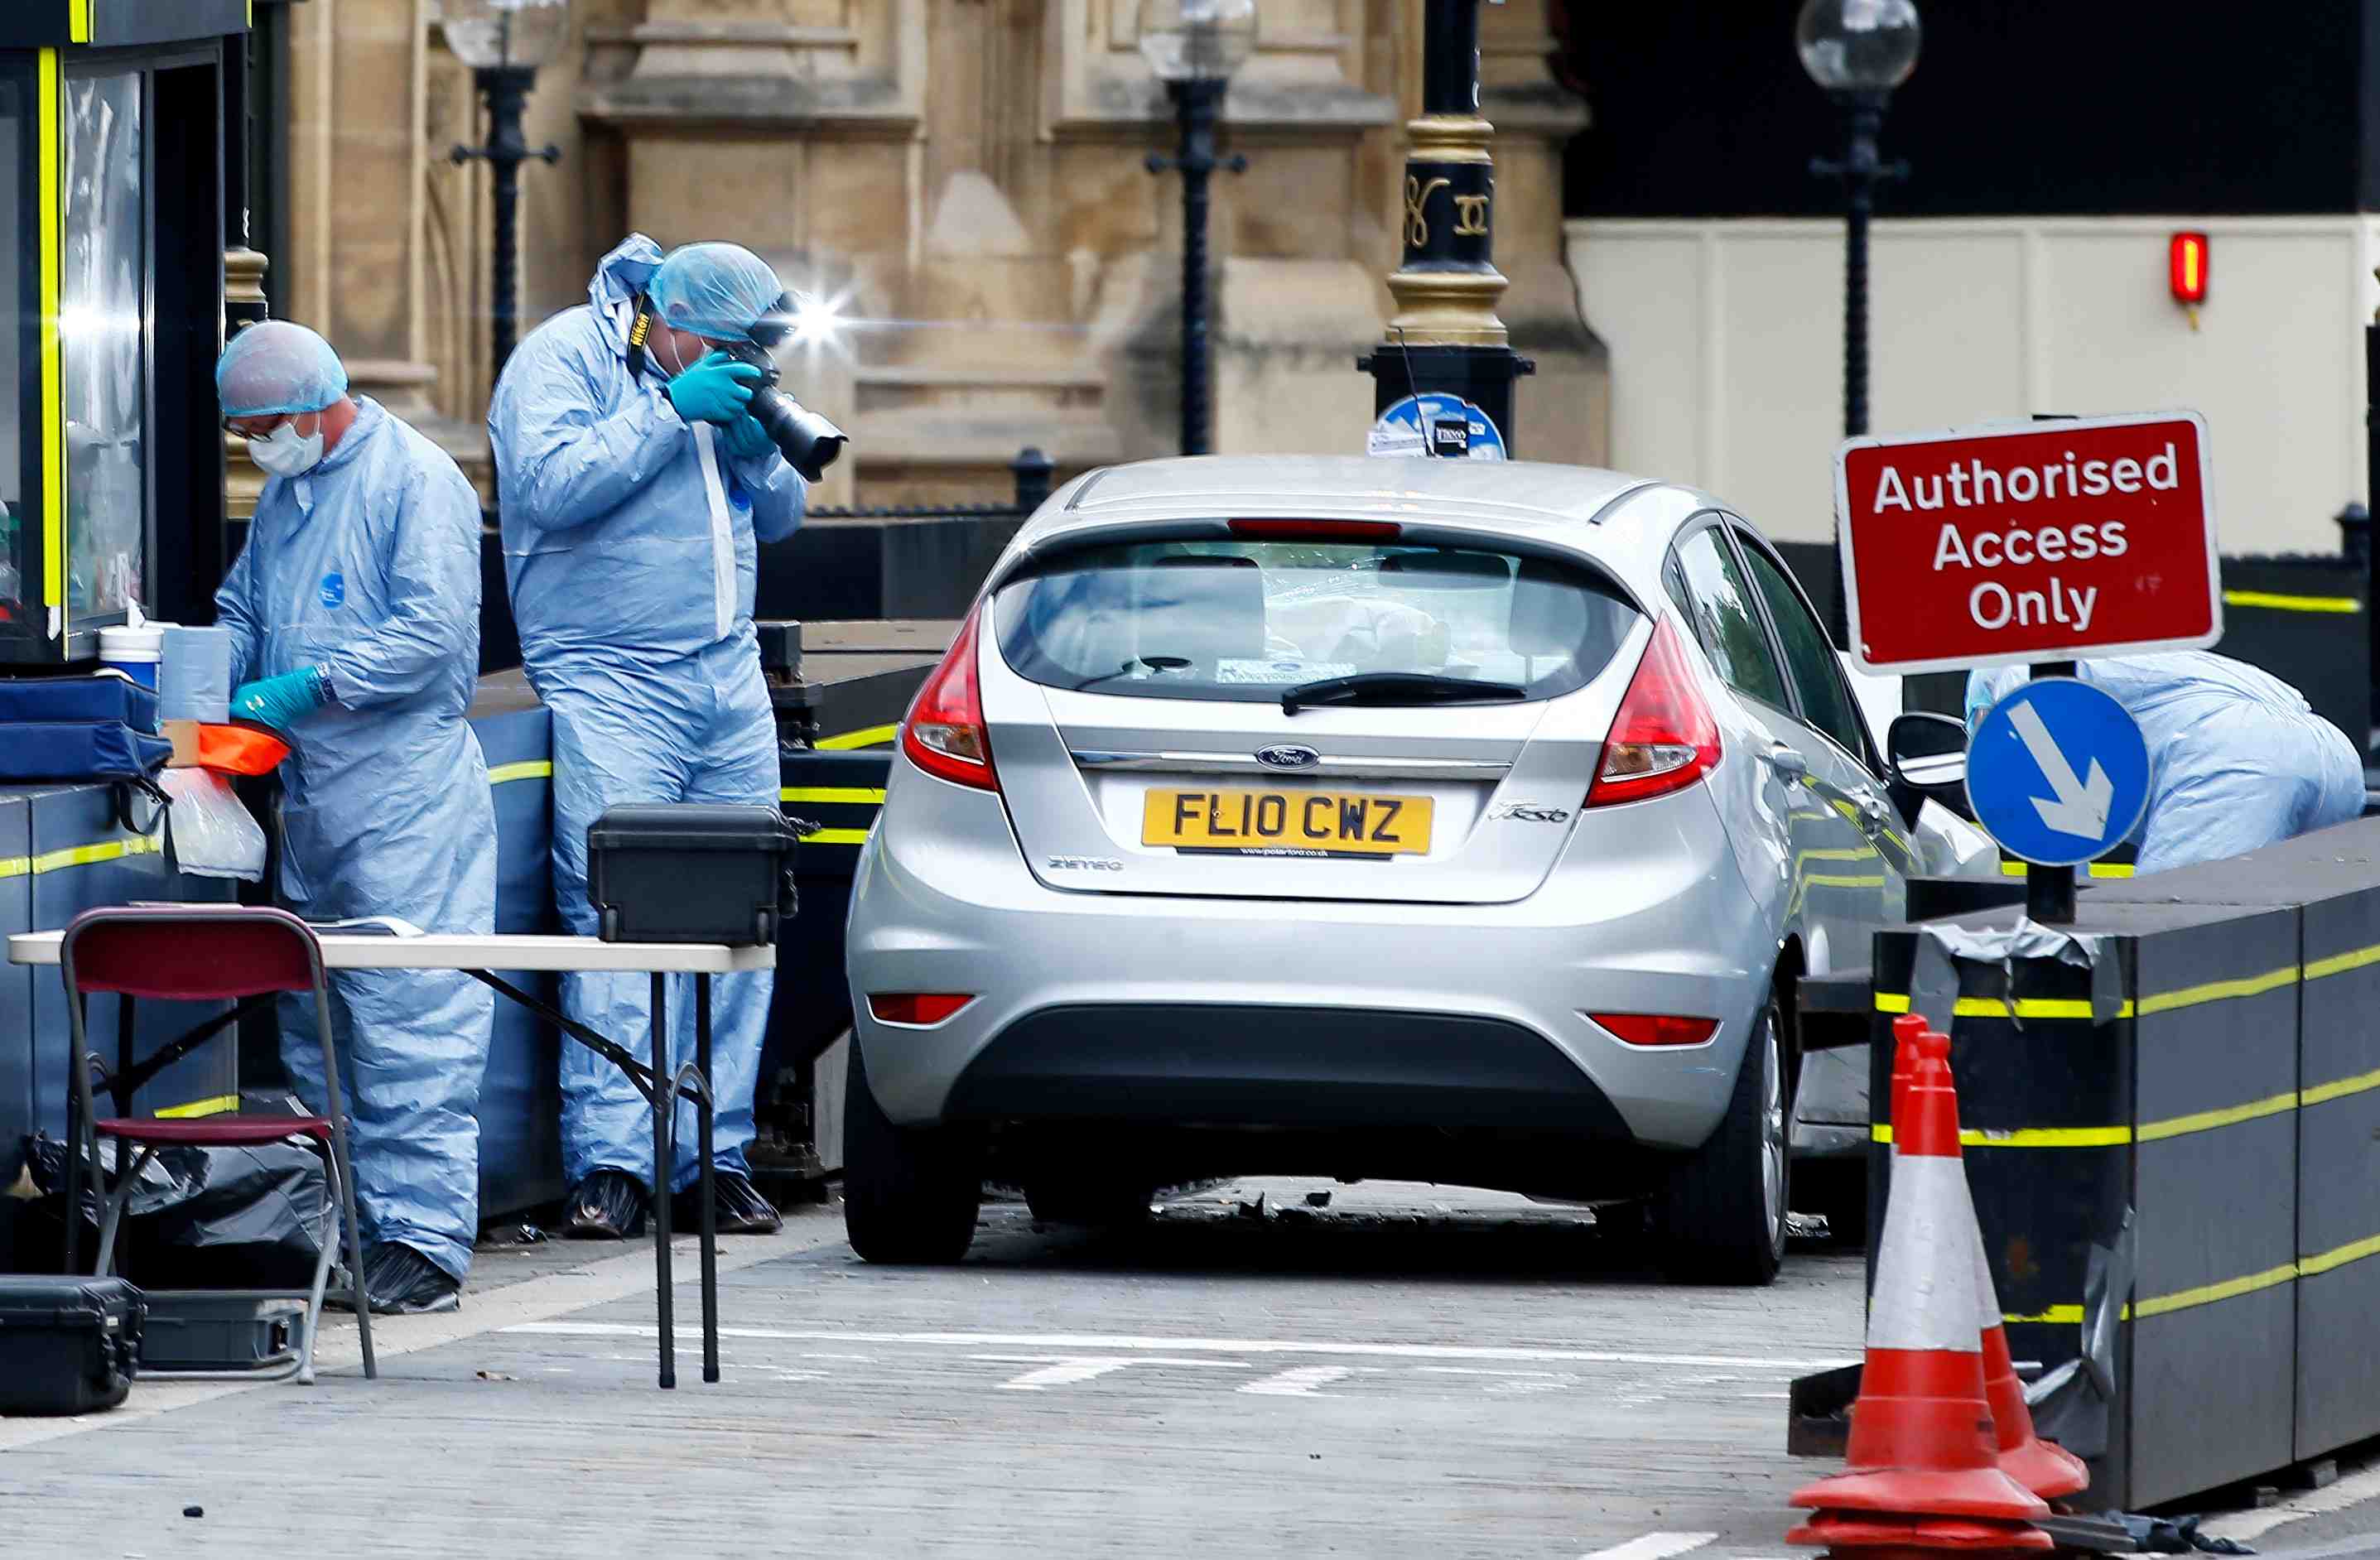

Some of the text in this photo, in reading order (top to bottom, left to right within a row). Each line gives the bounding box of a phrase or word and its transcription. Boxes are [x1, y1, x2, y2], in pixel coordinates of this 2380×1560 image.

[1873, 441, 2180, 514] Authorised
[1934, 520, 2129, 571] Access
[1969, 576, 2098, 632] Only
[1269, 748, 1306, 764] Ford
[1173, 792, 1404, 843] FL10 CWZ
